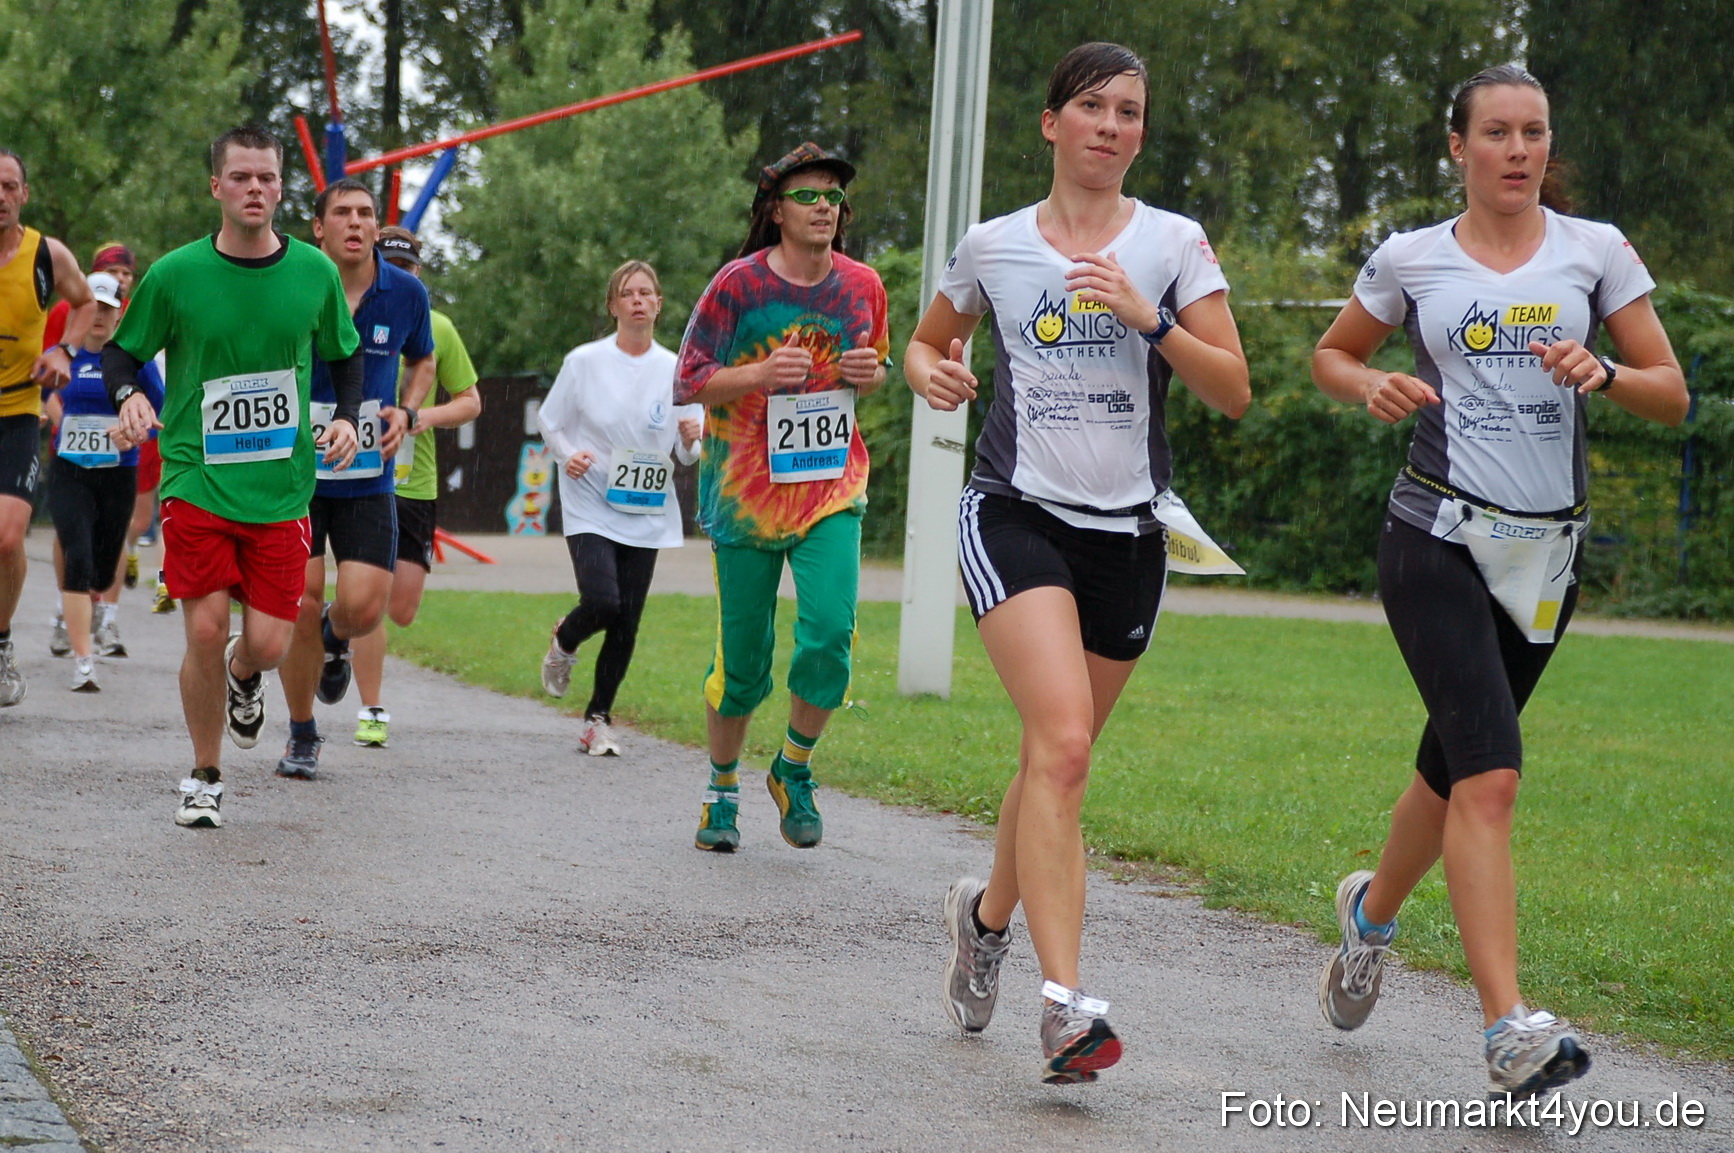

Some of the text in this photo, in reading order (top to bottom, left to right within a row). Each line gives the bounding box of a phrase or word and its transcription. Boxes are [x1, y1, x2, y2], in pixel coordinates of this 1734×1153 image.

[1511, 306, 1552, 323] TEAM
[1038, 346, 1116, 361] APOTHEKE
[1088, 390, 1131, 403] sanitär
[212, 393, 290, 431] 2058
[1517, 400, 1560, 414] sanitär
[777, 413, 850, 449] 2184
[67, 431, 111, 451] 2261
[235, 437, 271, 450] Helge
[792, 455, 840, 469] Andreas
[614, 464, 668, 491] 2189
[1493, 522, 1547, 540] BOCK
